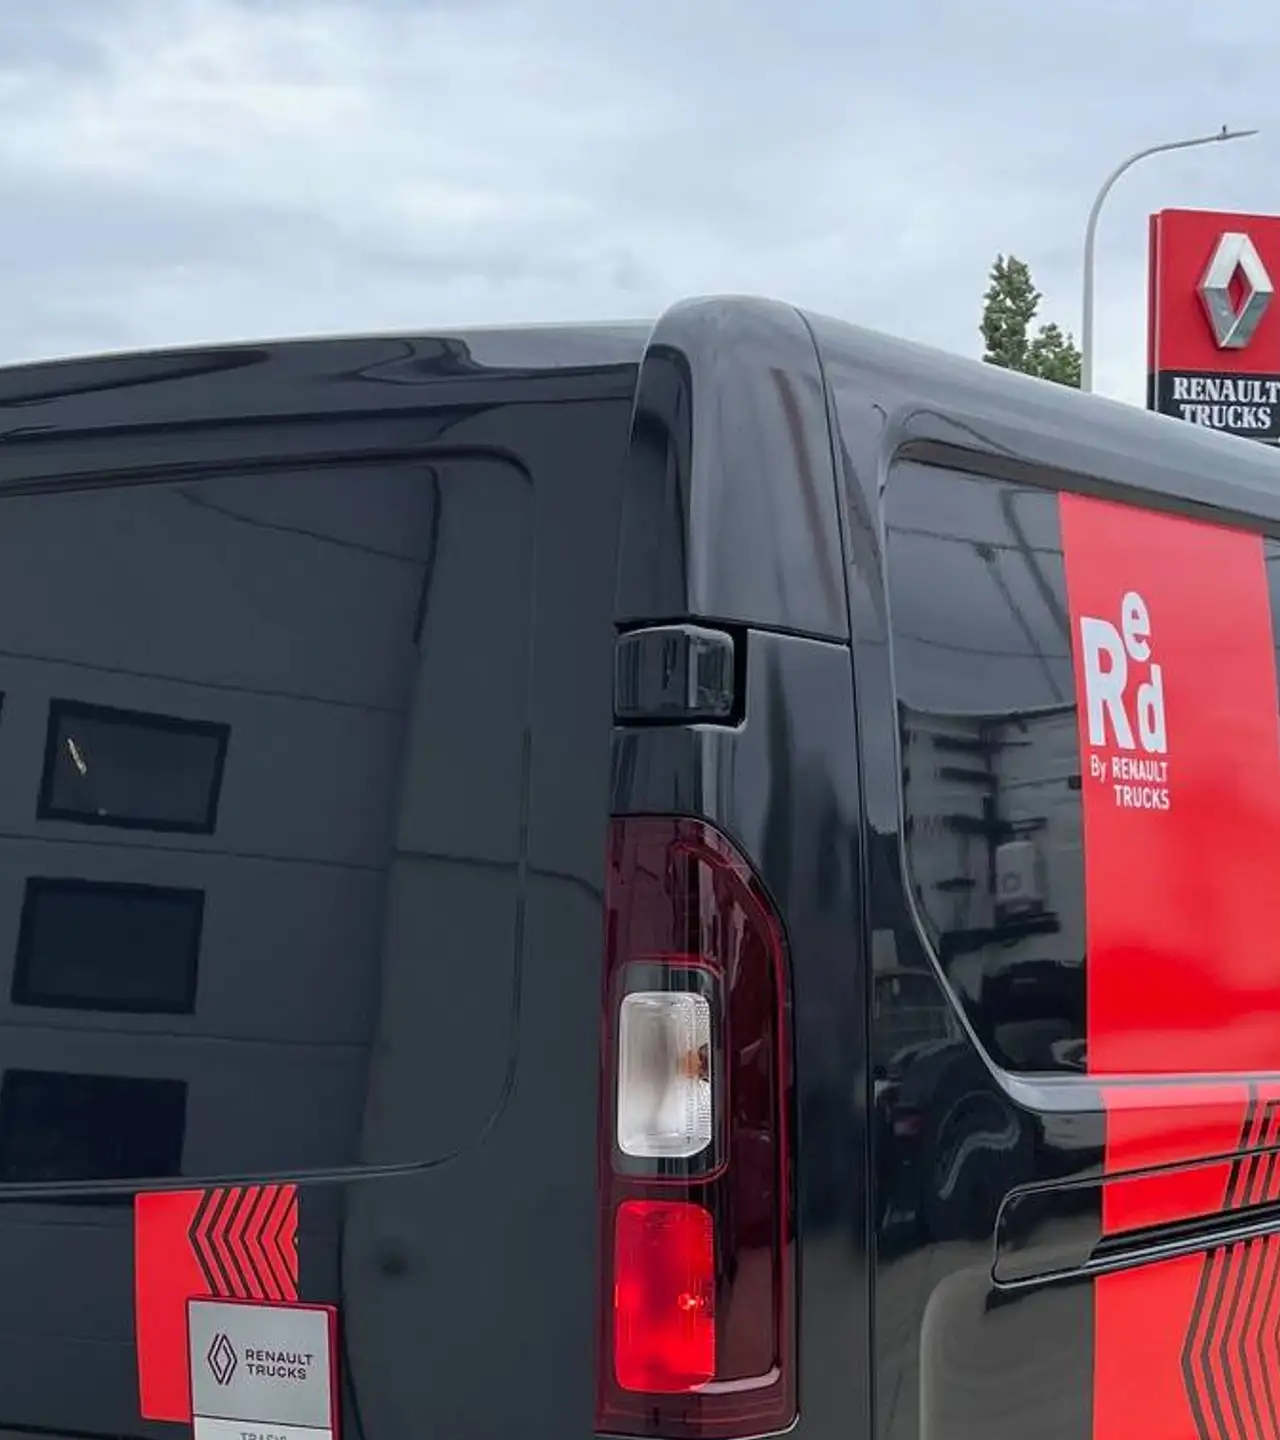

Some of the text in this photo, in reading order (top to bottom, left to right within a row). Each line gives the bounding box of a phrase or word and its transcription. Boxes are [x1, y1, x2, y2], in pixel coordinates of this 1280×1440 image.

[1173, 377, 1280, 403] RENAULT
[1180, 405, 1271, 428] TRUCKS
[1090, 754, 1167, 783] By RENAULT
[1114, 785, 1171, 810] TRUCKS
[246, 1350, 313, 1365] RENAULT
[247, 1365, 306, 1379] TRUCKS
